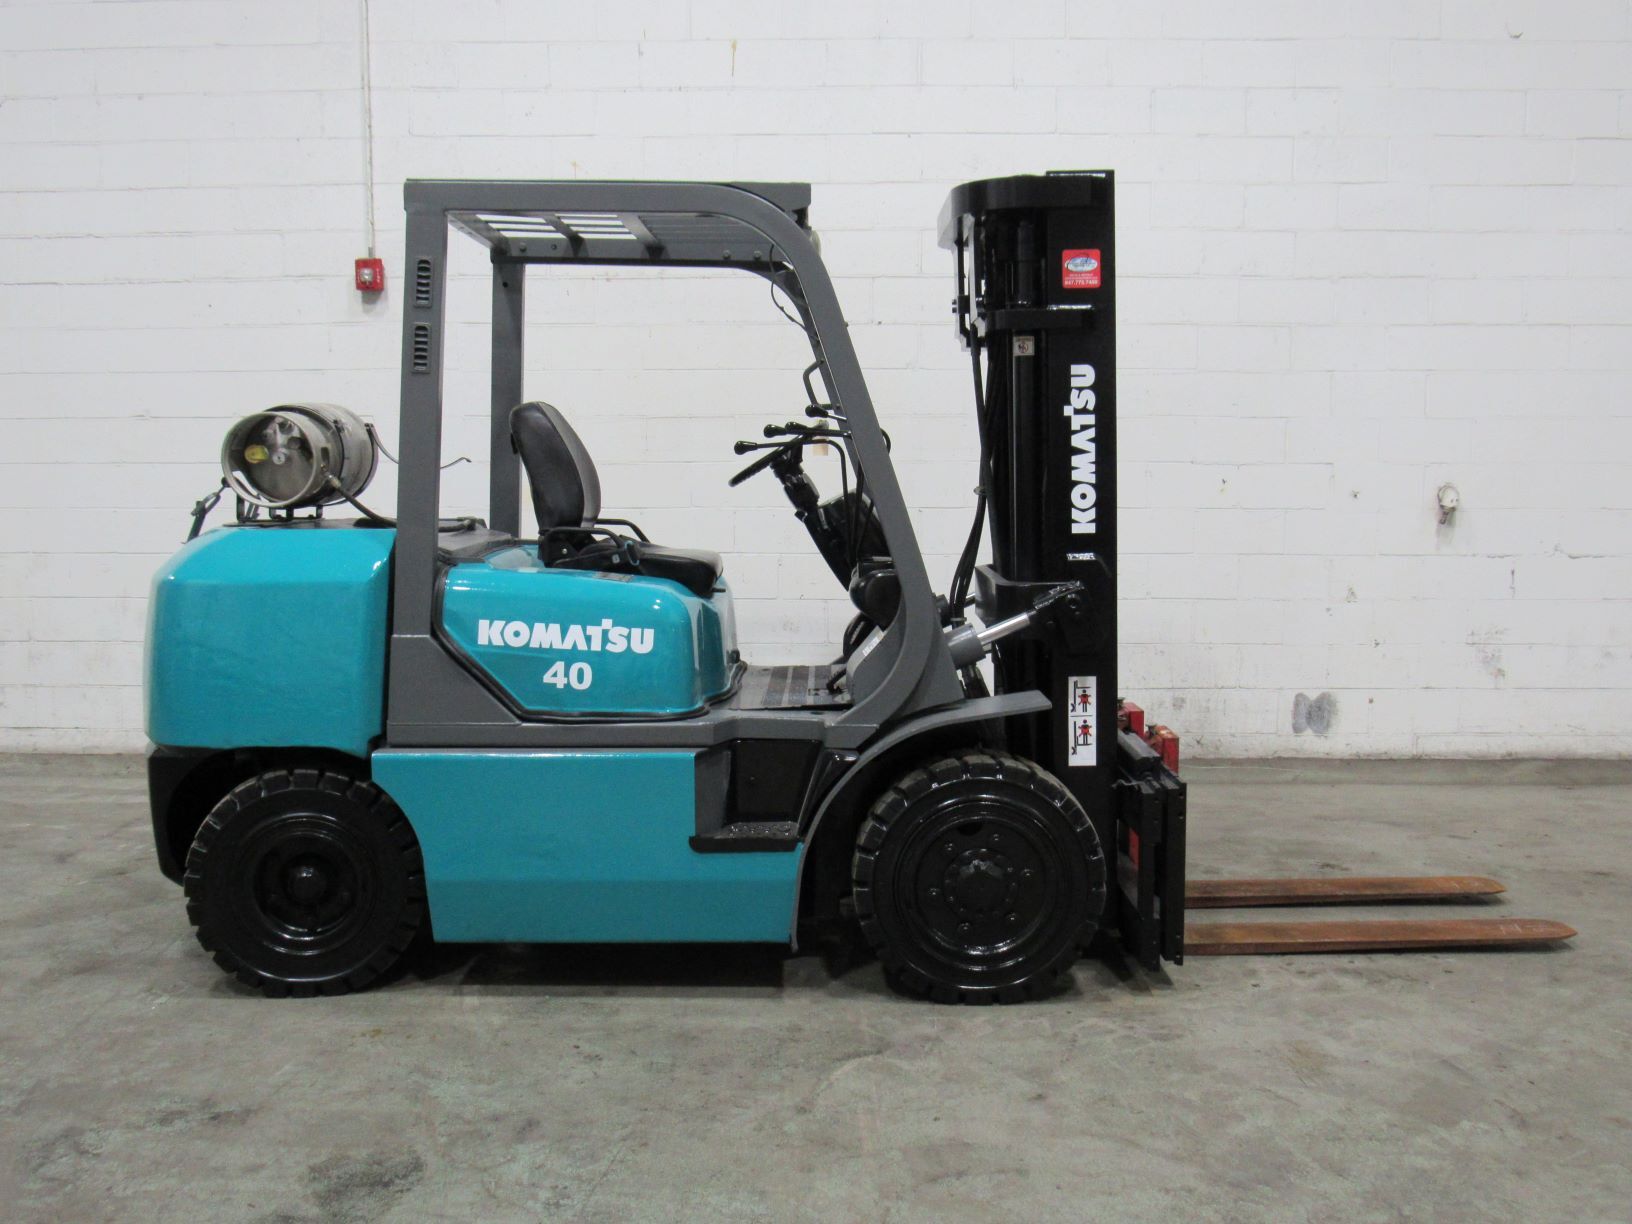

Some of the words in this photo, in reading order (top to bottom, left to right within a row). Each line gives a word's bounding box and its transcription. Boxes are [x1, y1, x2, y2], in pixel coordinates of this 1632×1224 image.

[1063, 363, 1097, 534] KOMATSU
[477, 618, 655, 654] KOMATSU
[543, 661, 593, 690] 40
